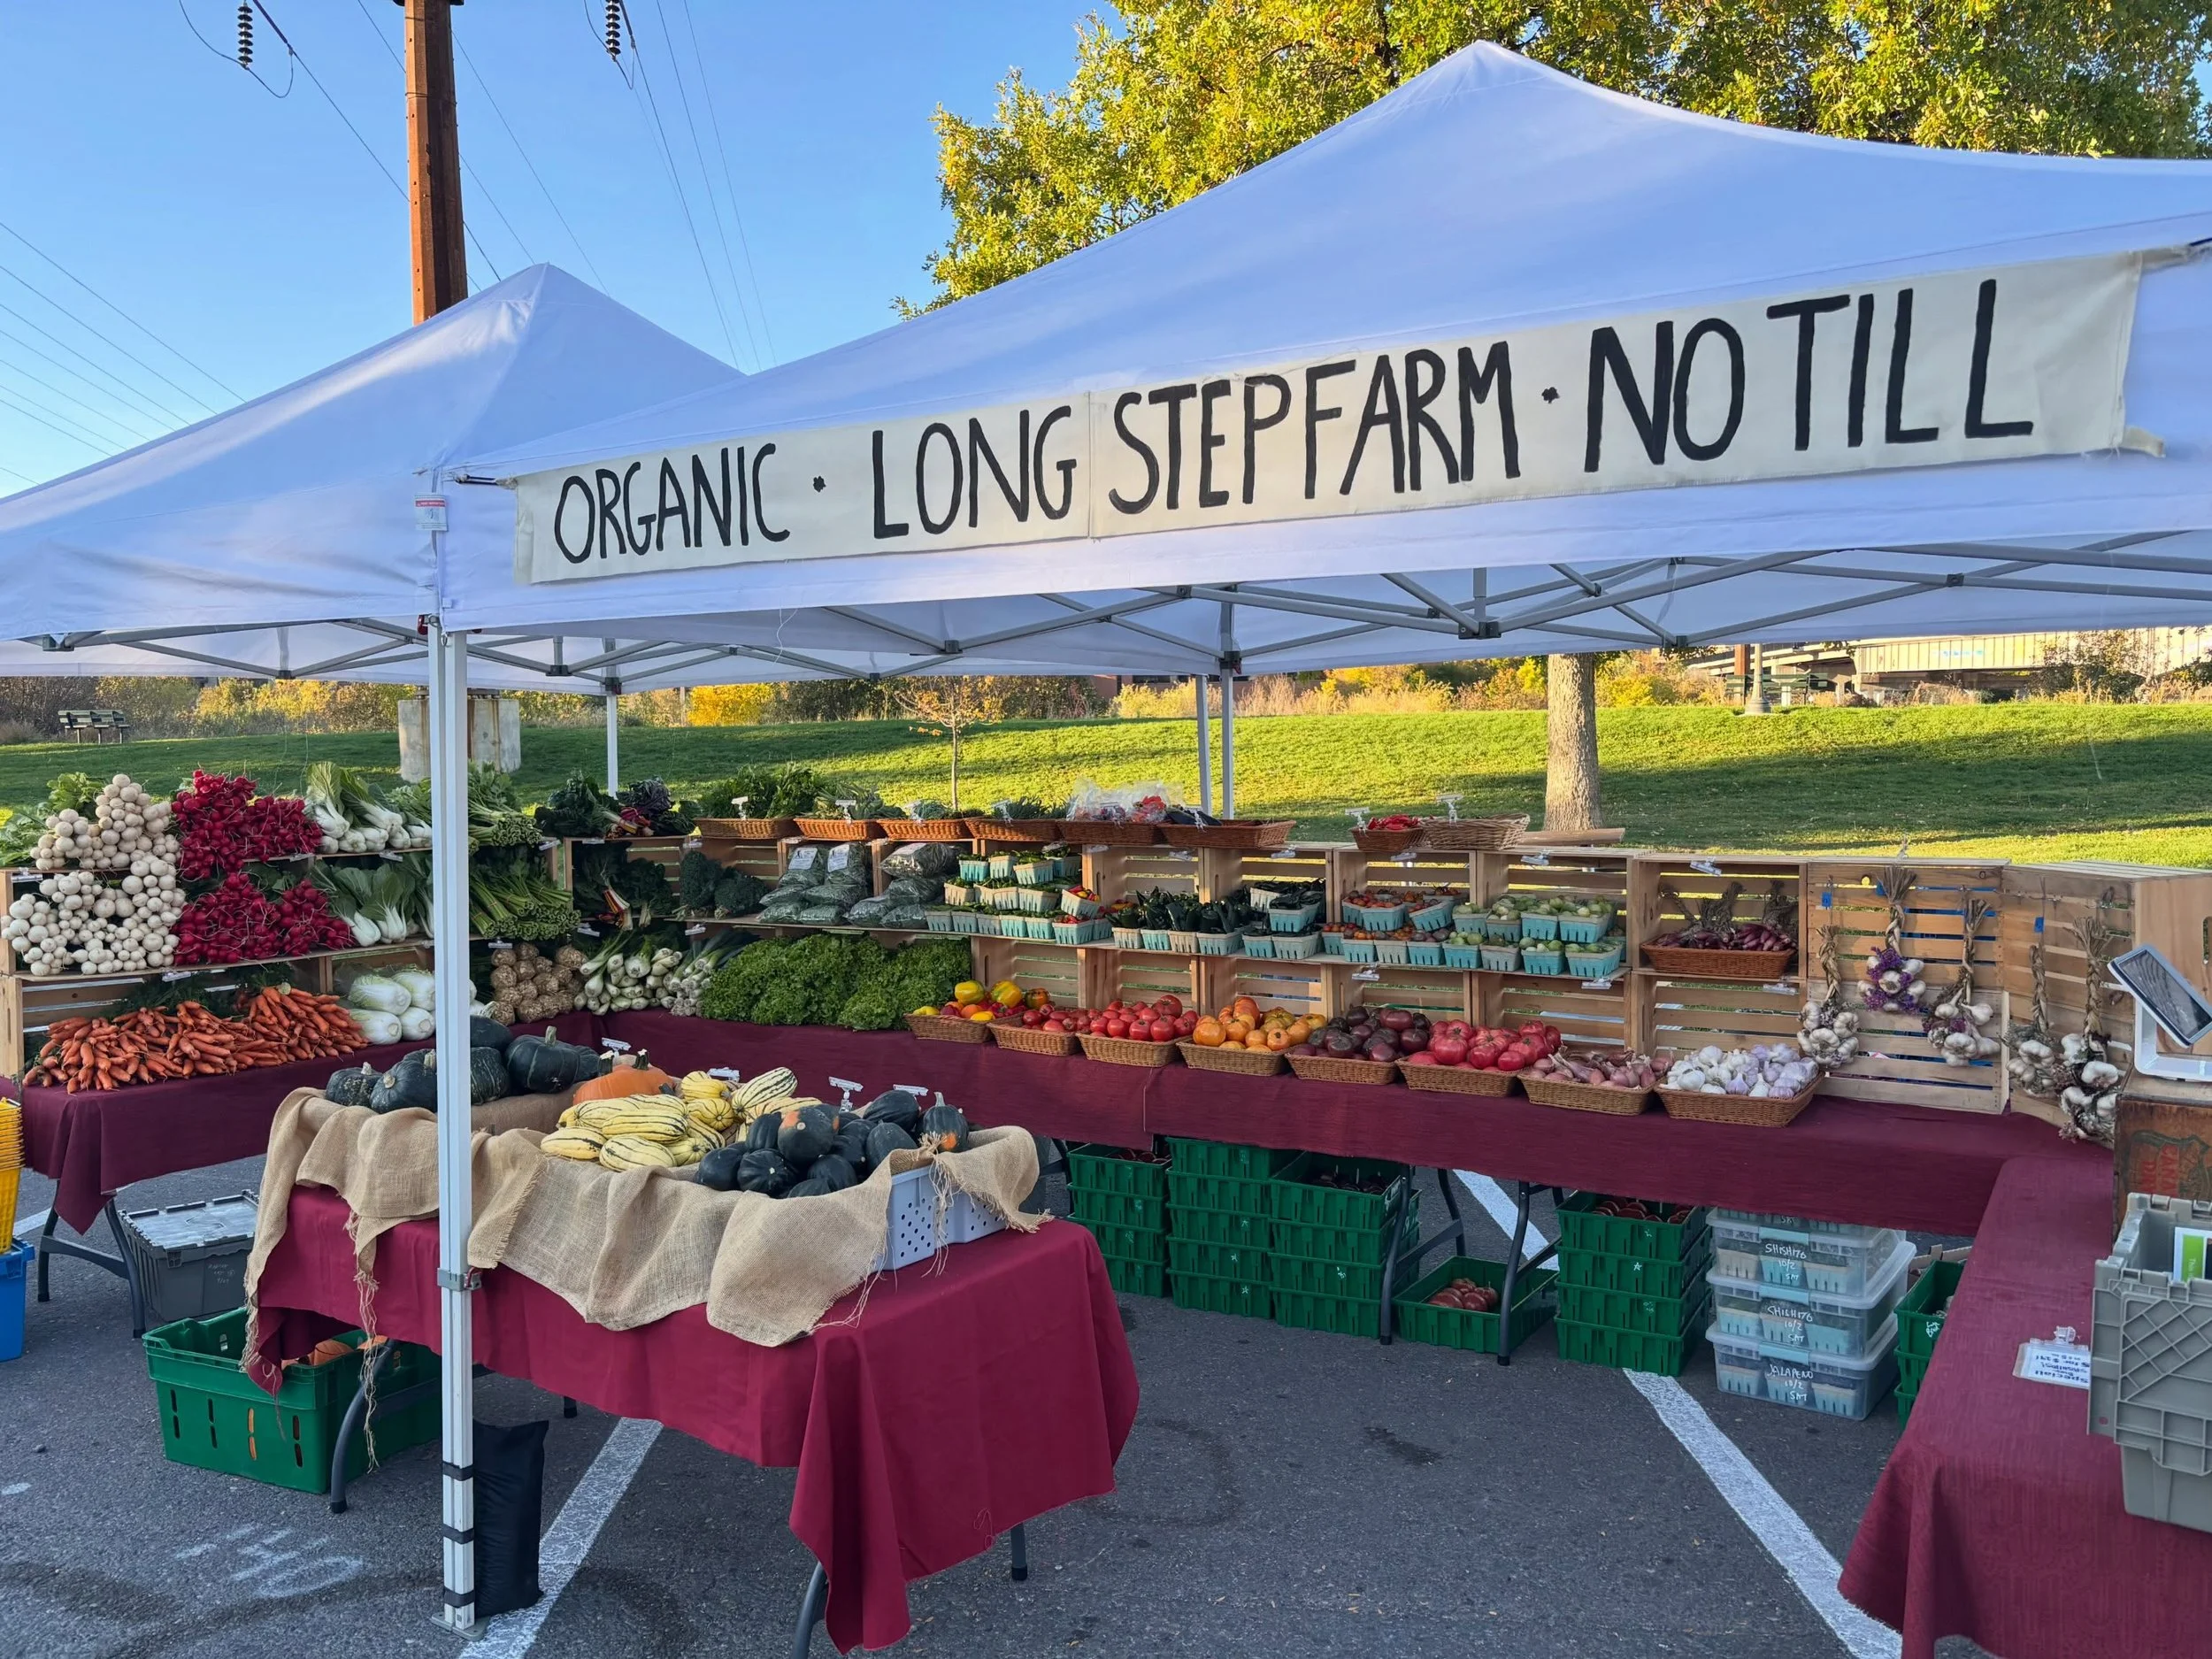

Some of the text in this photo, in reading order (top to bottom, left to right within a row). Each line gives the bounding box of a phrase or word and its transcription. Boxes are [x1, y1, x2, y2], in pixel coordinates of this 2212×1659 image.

[554, 279, 2034, 565] ORGANIC LONG STEP FARM NO TILL
[1766, 1363, 1814, 1379] JALAPENO
